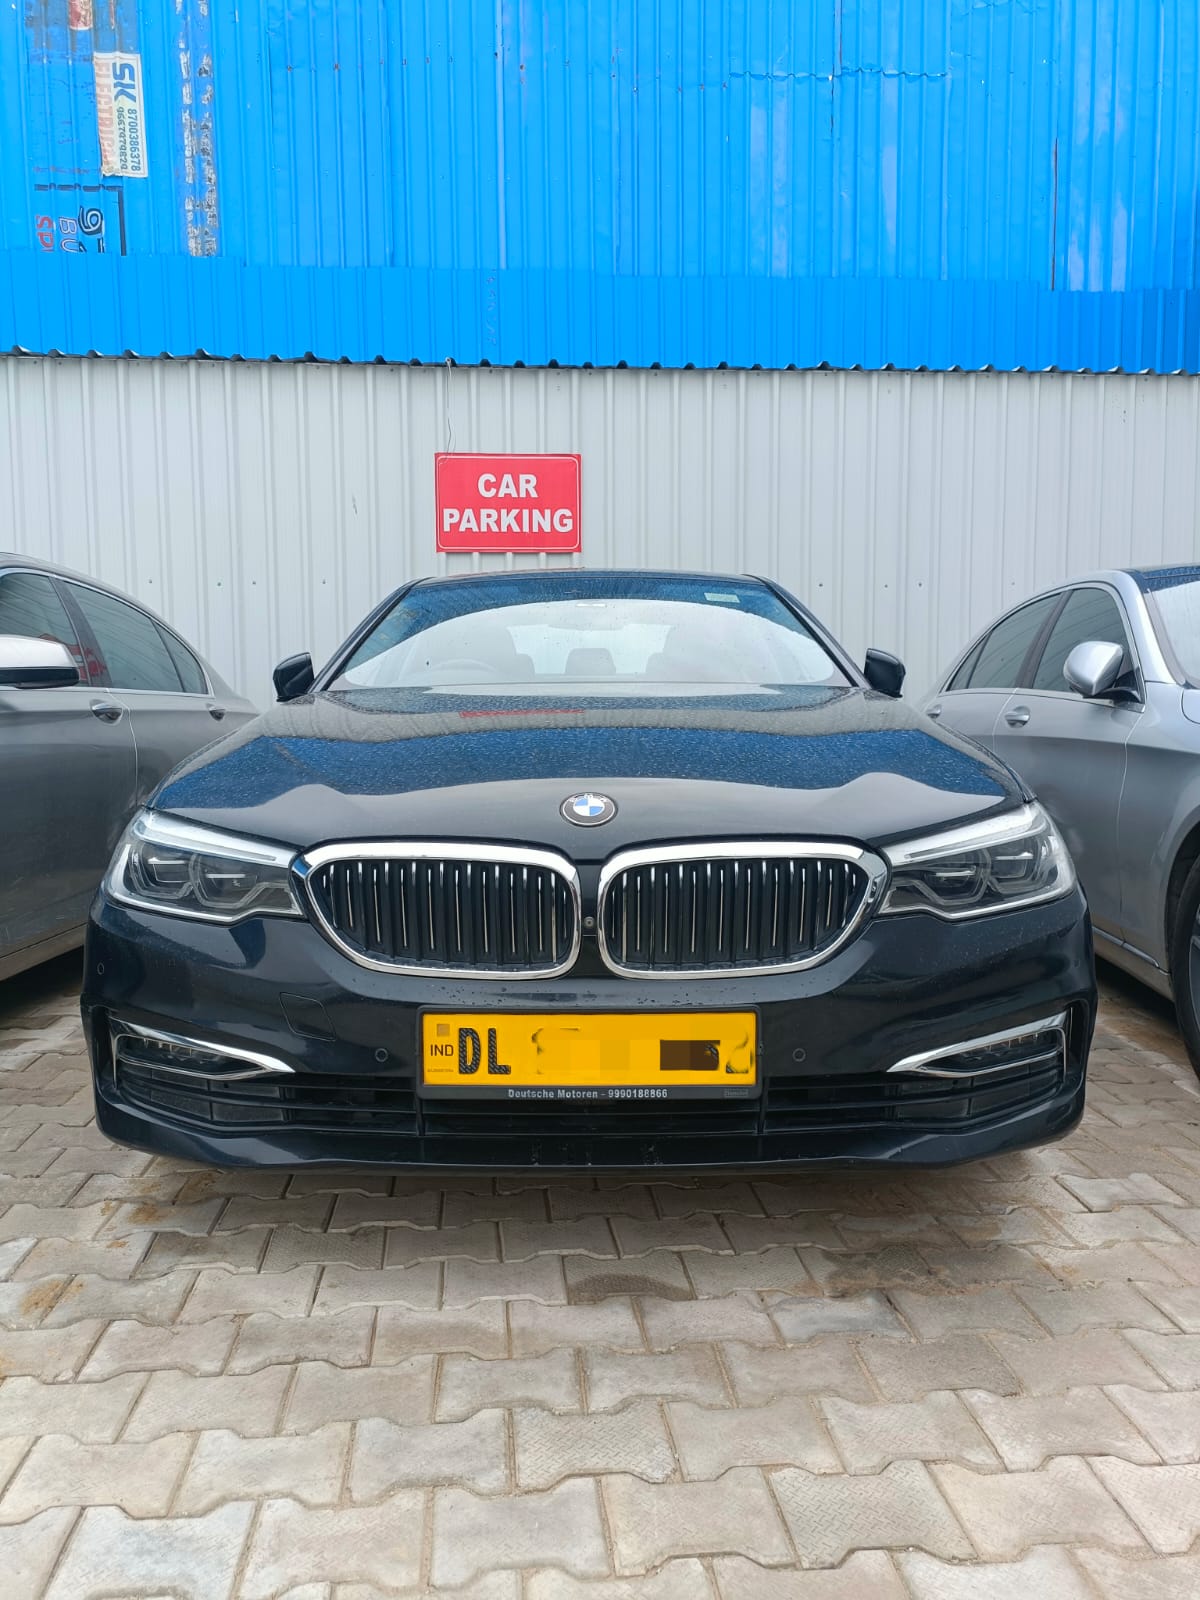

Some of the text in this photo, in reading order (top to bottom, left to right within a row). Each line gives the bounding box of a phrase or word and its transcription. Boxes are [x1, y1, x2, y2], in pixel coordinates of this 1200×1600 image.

[113, 64, 137, 103] SK
[127, 108, 141, 172] 8700386378
[477, 473, 538, 498] CAR
[443, 508, 574, 533] PARKING
[430, 1044, 454, 1057] IND
[458, 1027, 512, 1075] DL
[508, 1088, 554, 1098] Deutsche
[557, 1088, 598, 1098] Motoren
